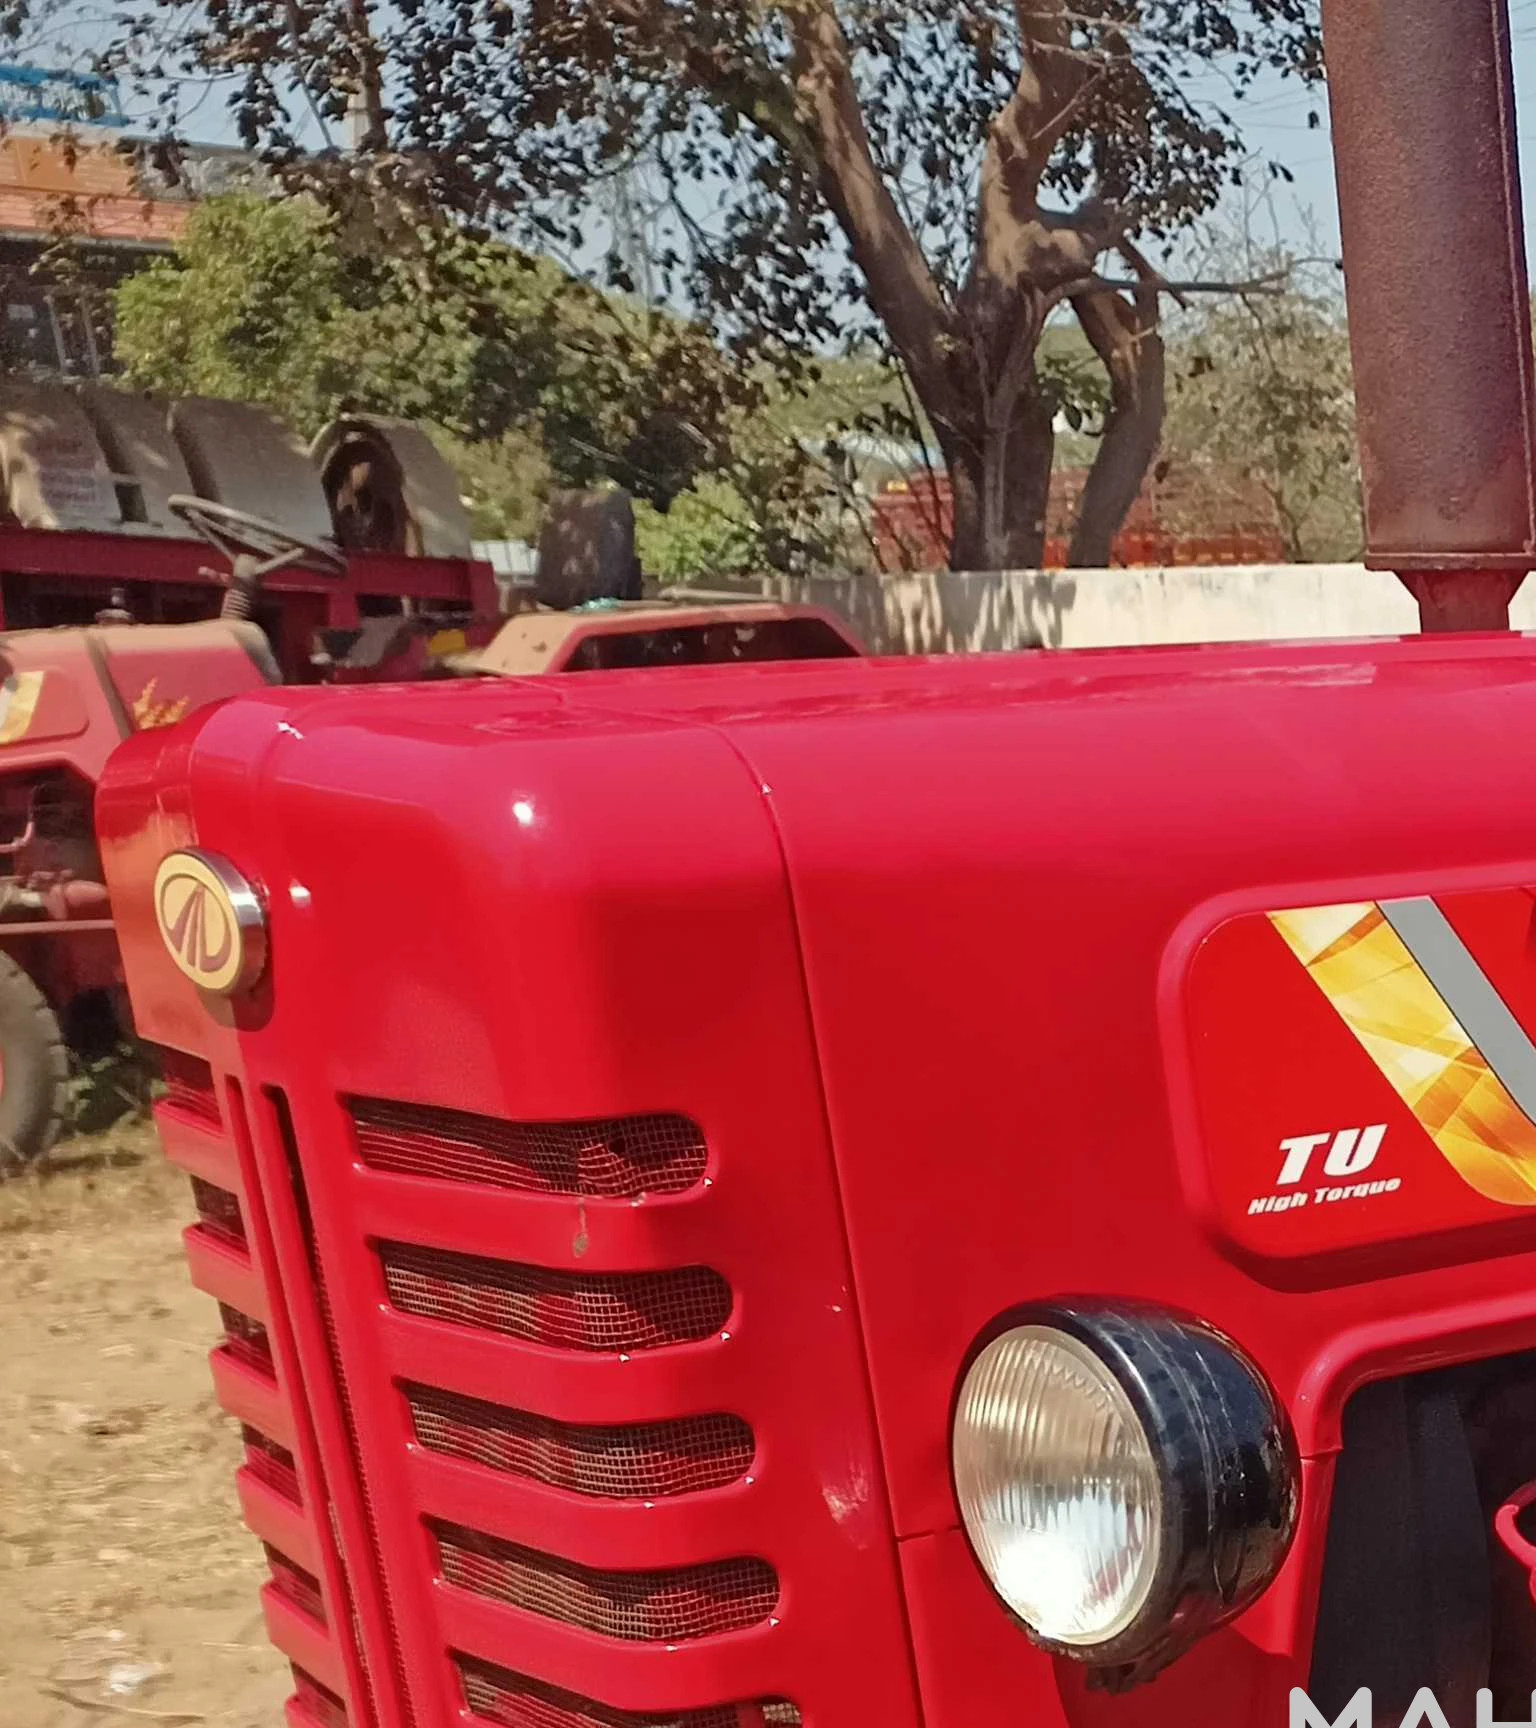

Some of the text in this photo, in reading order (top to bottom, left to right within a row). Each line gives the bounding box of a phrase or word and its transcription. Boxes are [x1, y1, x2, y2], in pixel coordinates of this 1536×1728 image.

[1276, 1123, 1388, 1185] TU
[1247, 1177, 1402, 1216] High Torque
